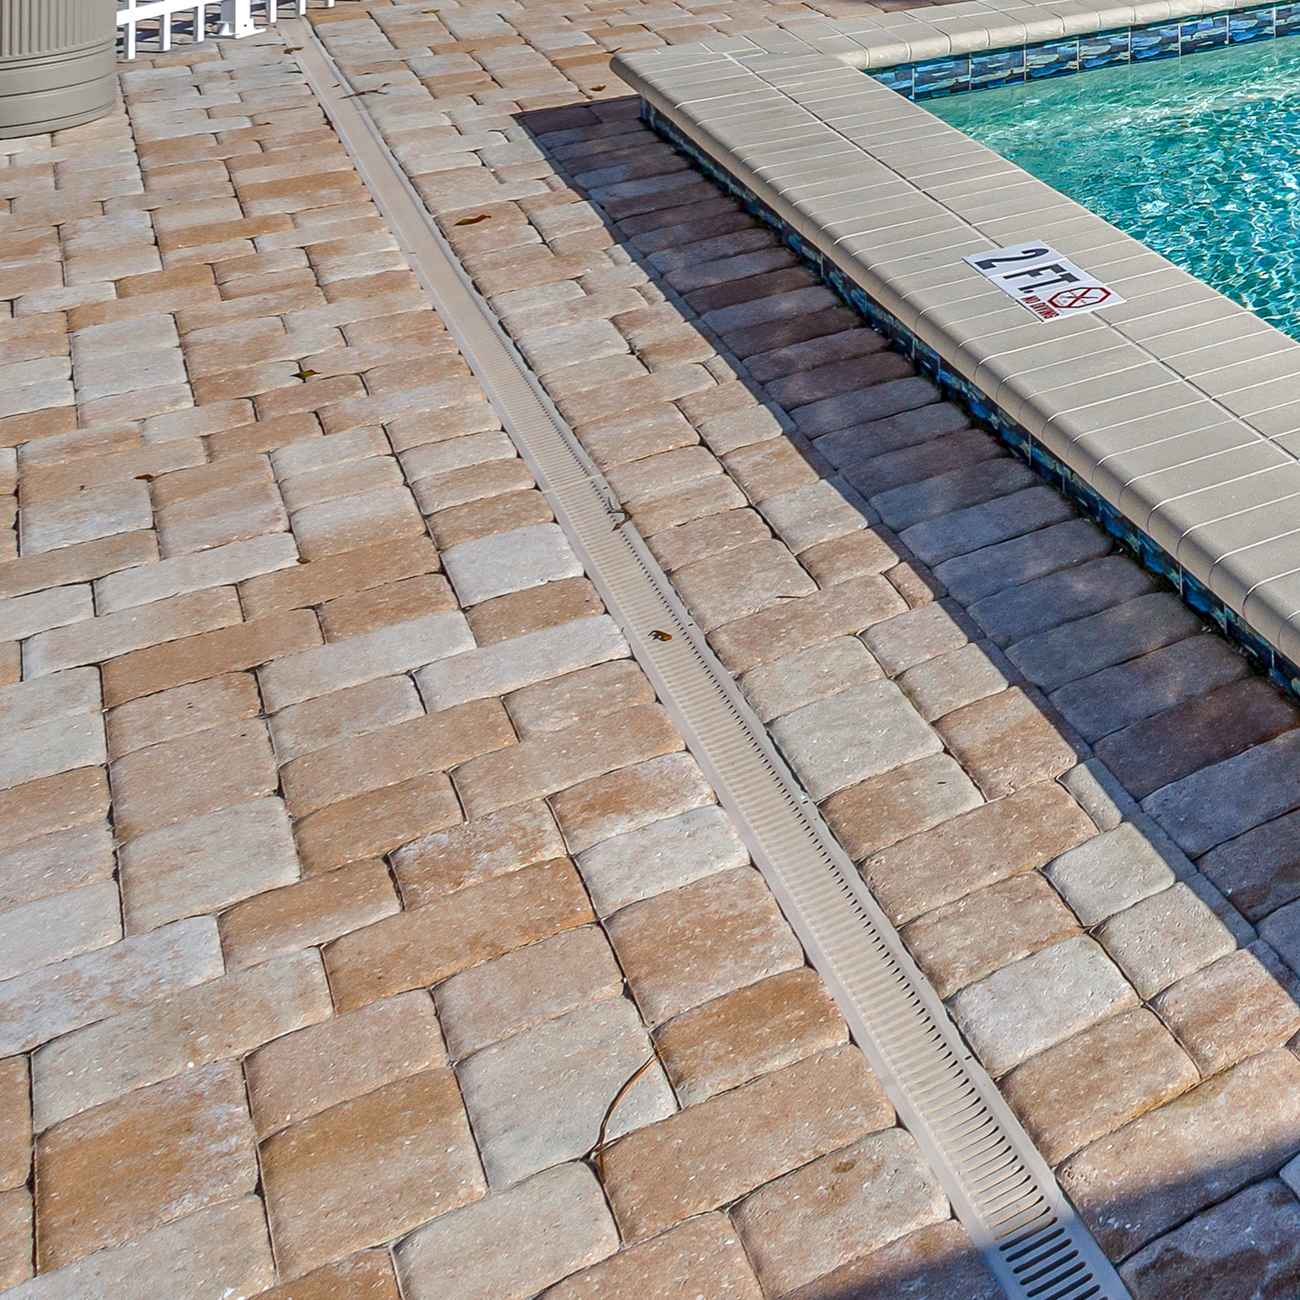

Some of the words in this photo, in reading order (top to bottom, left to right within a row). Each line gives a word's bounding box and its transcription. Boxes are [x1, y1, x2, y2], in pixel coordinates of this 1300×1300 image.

[974, 248, 1050, 270] 2
[1003, 264, 1080, 294] FT.
[1020, 295, 1041, 304] NO
[1029, 302, 1060, 319] DIVING
